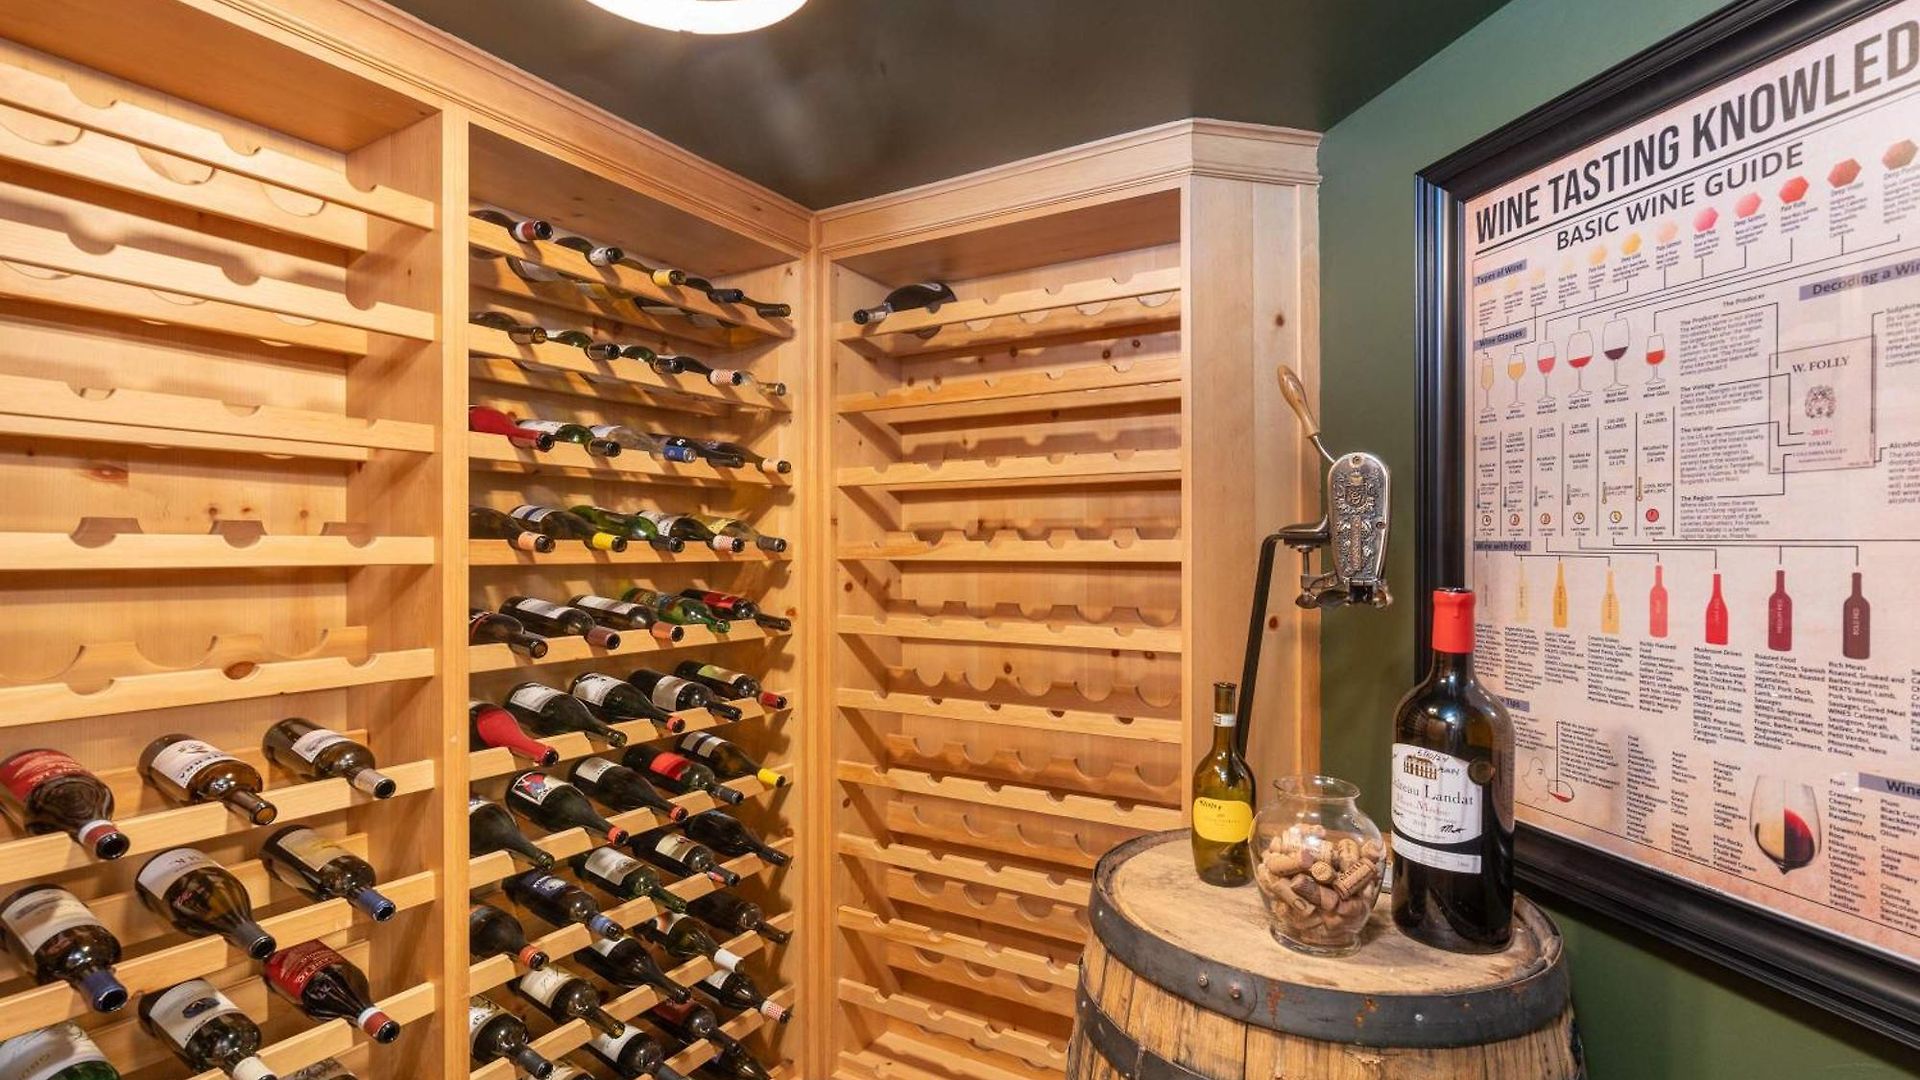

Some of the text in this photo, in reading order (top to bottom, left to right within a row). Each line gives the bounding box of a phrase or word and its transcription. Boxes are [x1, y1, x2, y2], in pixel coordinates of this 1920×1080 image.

[1476, 20, 1919, 244] WINE TASTING KNOWLED
[1557, 142, 1803, 250] BASIC WINE GUIDE
[1477, 263, 1523, 284] Types of Wine
[1813, 273, 1878, 295] Decoding
[1882, 270, 1891, 279] a
[1480, 330, 1523, 347] Wine Glasses
[1792, 356, 1850, 373] W. FOLLY
[1493, 542, 1509, 550] with
[1510, 542, 1528, 551] Food
[1829, 661, 1844, 669] Rich
[1860, 673, 1889, 683] Smoked
[1507, 699, 1521, 709] Tips
[1863, 705, 1886, 714] Cured
[1713, 780, 1721, 788] Fig
[1830, 779, 1846, 787] Fruit
[1425, 784, 1474, 805] Landat
[1829, 790, 1863, 803] Cranberry
[1829, 797, 1851, 809] Cherry
[1880, 798, 1900, 807] Plum
[1829, 804, 1866, 820] Strawberry
[1880, 806, 1900, 816] Black
[1829, 811, 1863, 826] Raspberry
[1829, 831, 1845, 840] Rose
[1830, 824, 1877, 842] Flower/Herb
[1880, 822, 1917, 837] Blueberry
[1880, 829, 1900, 839] Olive
[1829, 839, 1857, 852] Hibiscus
[1829, 846, 1866, 861] Eucalyptus
[1829, 853, 1860, 866] Lavender
[1880, 853, 1901, 864] Anise
[1880, 860, 1899, 871] Sage
[1830, 869, 1853, 881] Smoke
[1880, 868, 1919, 885] Rosemary
[1830, 876, 1859, 890] Tobacco
[1880, 883, 1902, 894] Clove
[1830, 884, 1867, 900] Mushroom
[1880, 891, 1911, 906] Nutmeg
[1880, 898, 1919, 915] Chocolate
[1880, 911, 1918, 932] Bacon Fat
